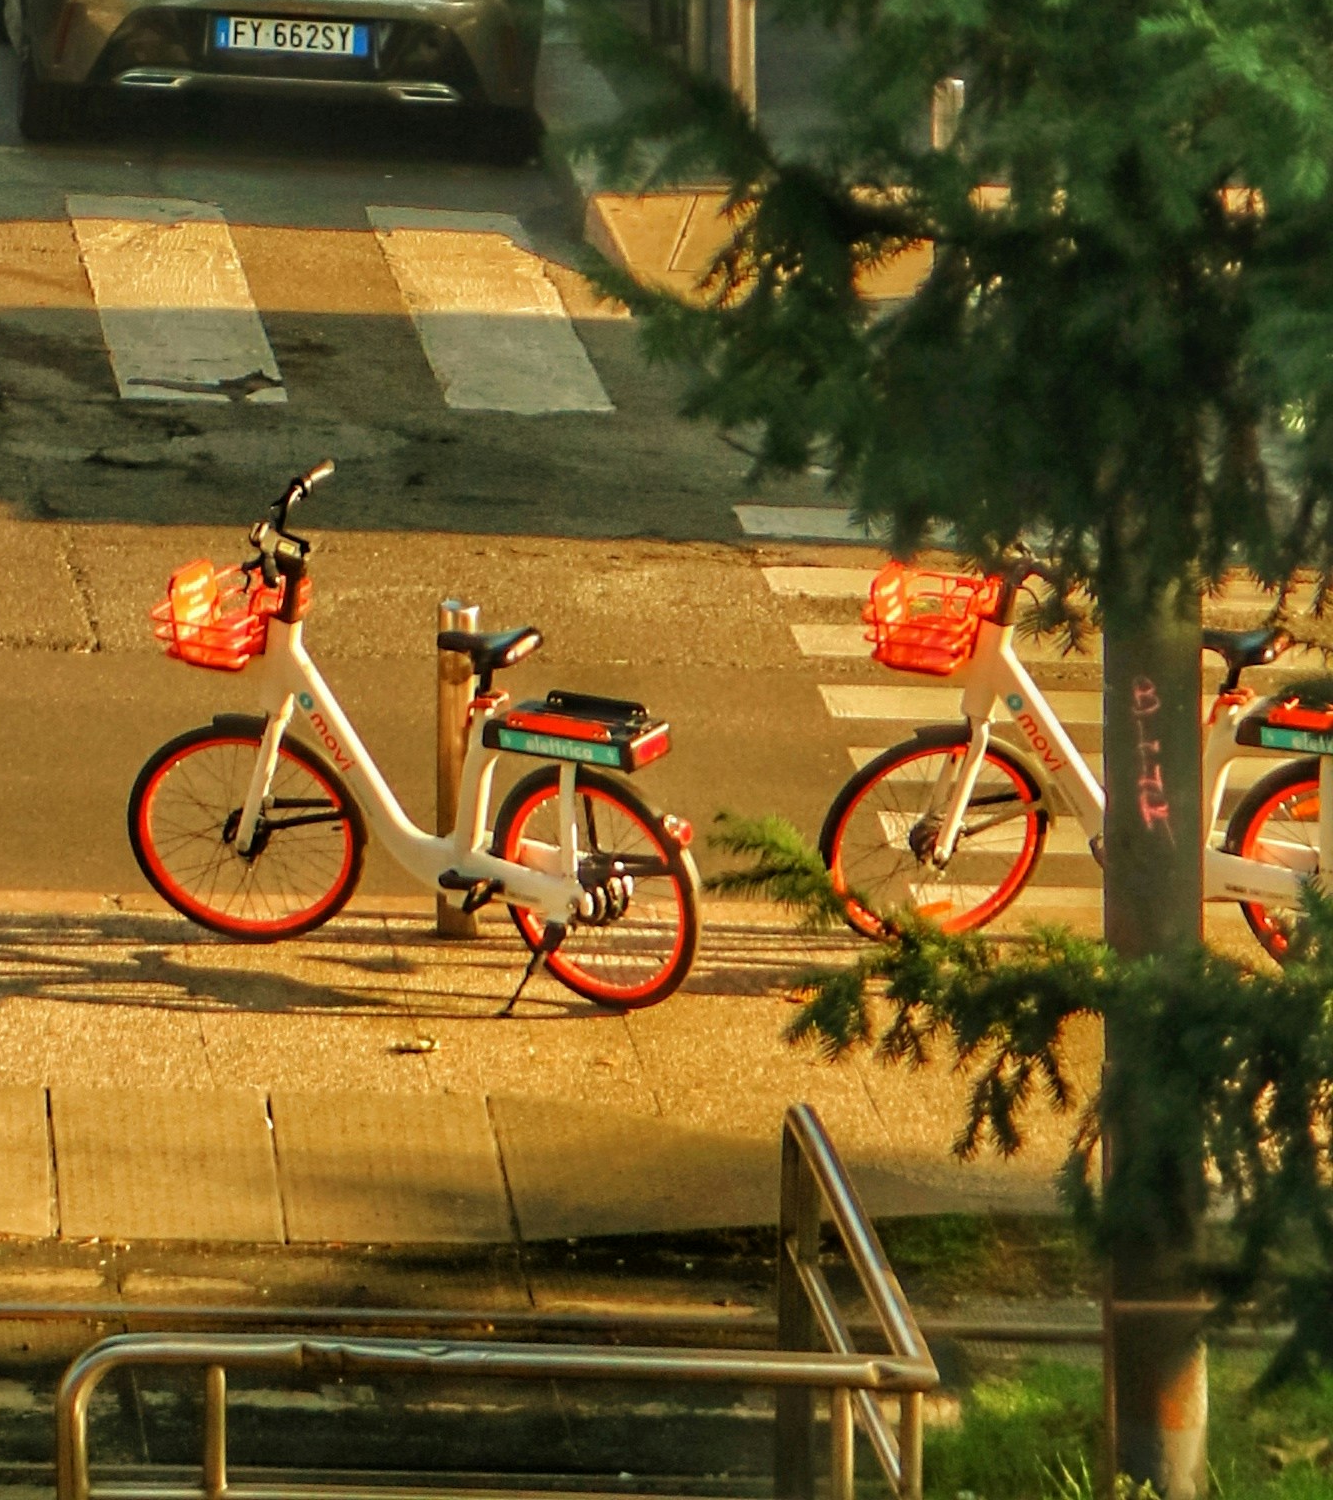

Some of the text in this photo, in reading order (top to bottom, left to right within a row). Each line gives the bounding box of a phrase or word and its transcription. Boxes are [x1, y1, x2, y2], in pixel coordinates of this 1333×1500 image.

[233, 20, 351, 51] FY 662SY
[310, 713, 355, 772] movi
[1017, 713, 1068, 772] movi
